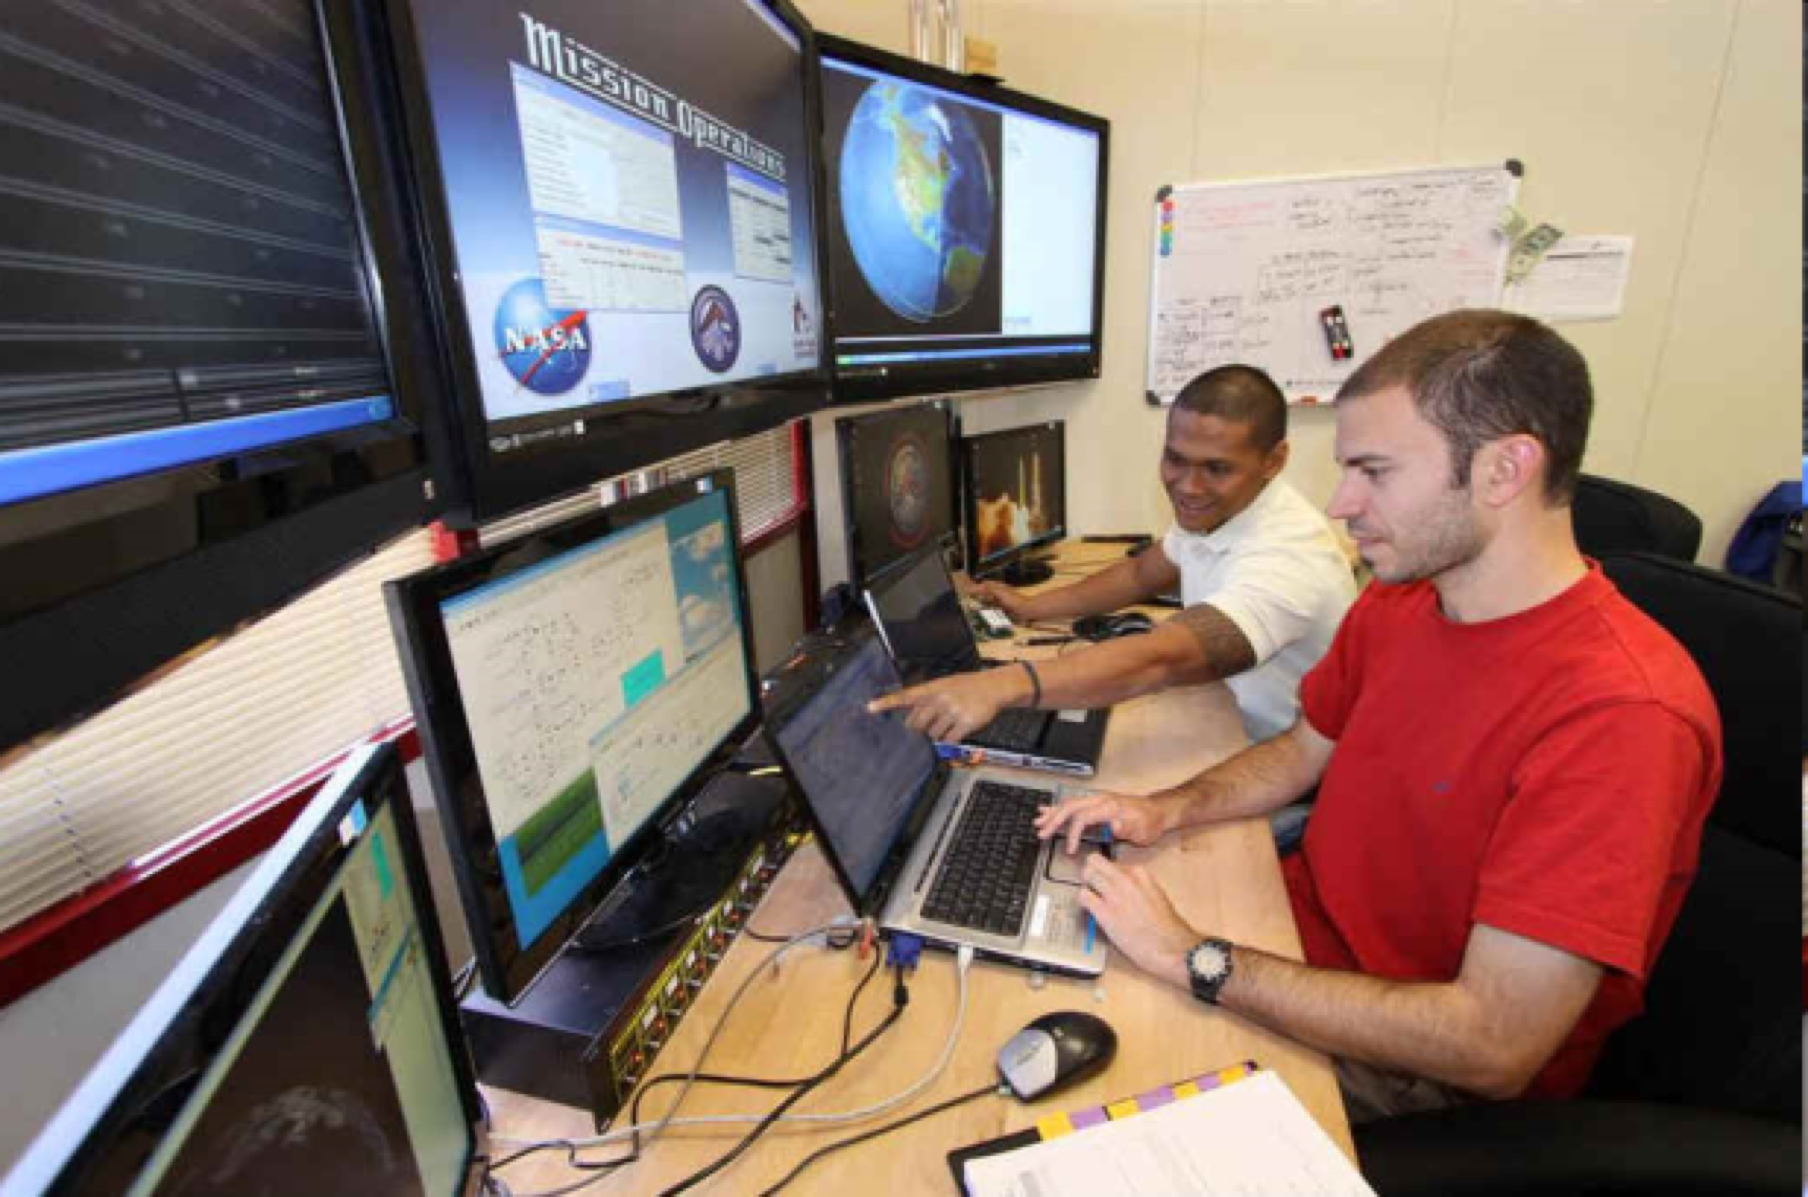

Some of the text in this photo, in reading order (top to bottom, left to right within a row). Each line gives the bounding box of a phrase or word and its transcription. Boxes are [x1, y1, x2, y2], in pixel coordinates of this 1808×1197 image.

[519, 11, 671, 120] Mission
[675, 99, 787, 180] Operations
[503, 325, 588, 353] NASA
